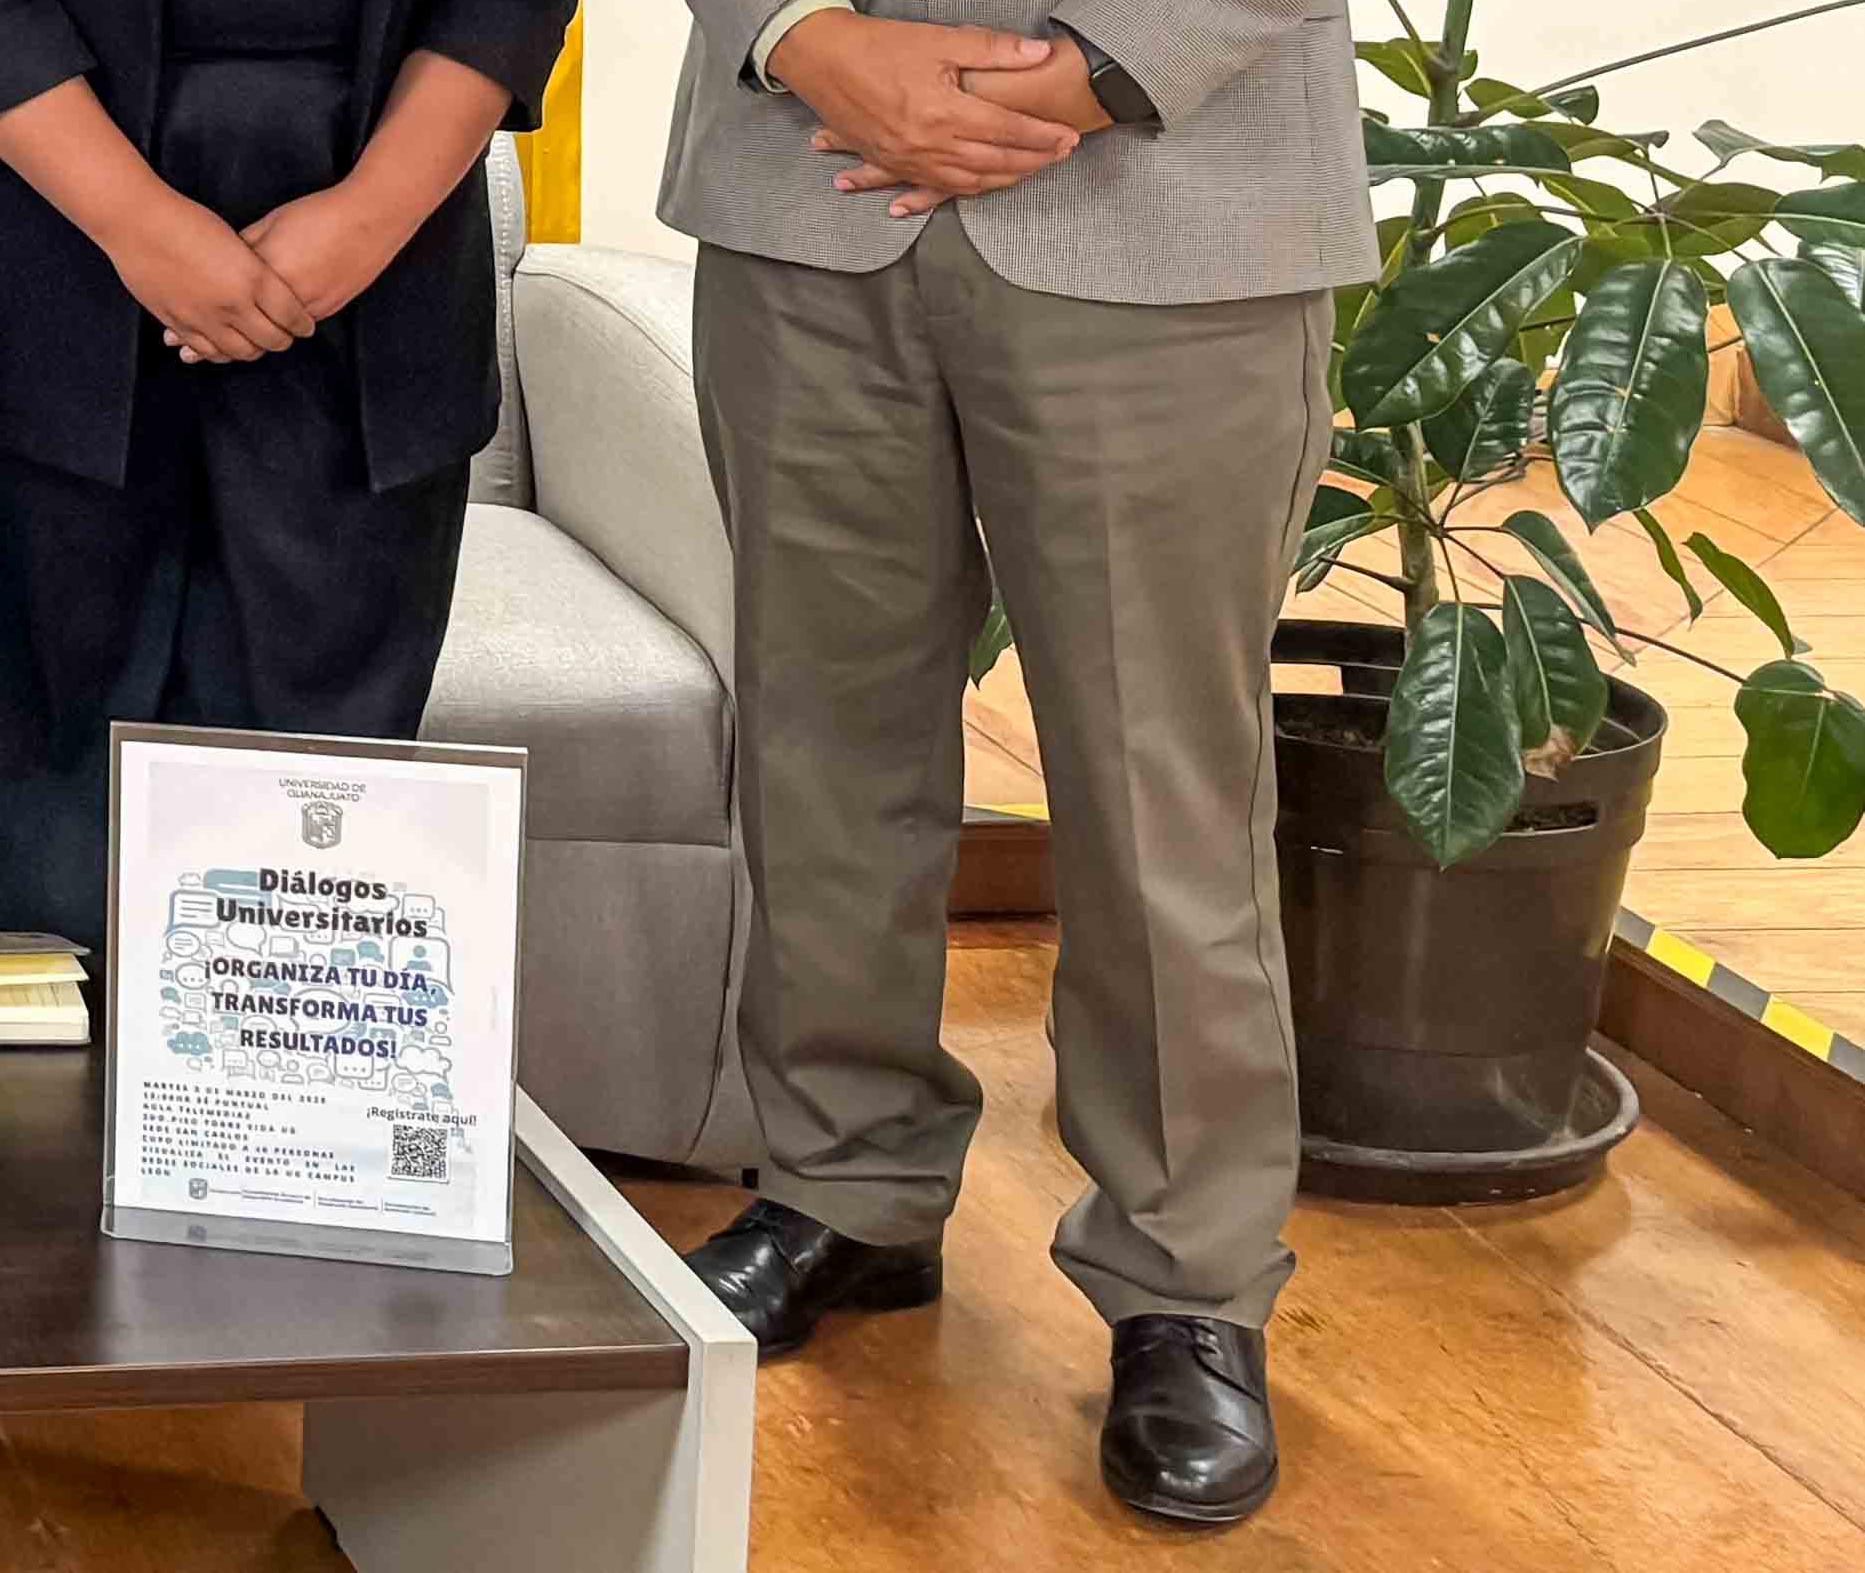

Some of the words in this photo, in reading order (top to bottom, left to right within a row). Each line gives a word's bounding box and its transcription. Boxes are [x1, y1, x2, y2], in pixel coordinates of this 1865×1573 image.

[259, 867, 387, 903] Diálogos
[217, 898, 427, 937] Universitarios
[205, 957, 341, 984] ¡ORGANIZA
[347, 968, 377, 987] TU
[383, 968, 436, 995] DÍA,
[211, 992, 378, 1022] TRANSFORMA
[384, 1005, 428, 1026] TUS
[240, 1029, 397, 1059] RESULTADOS!
